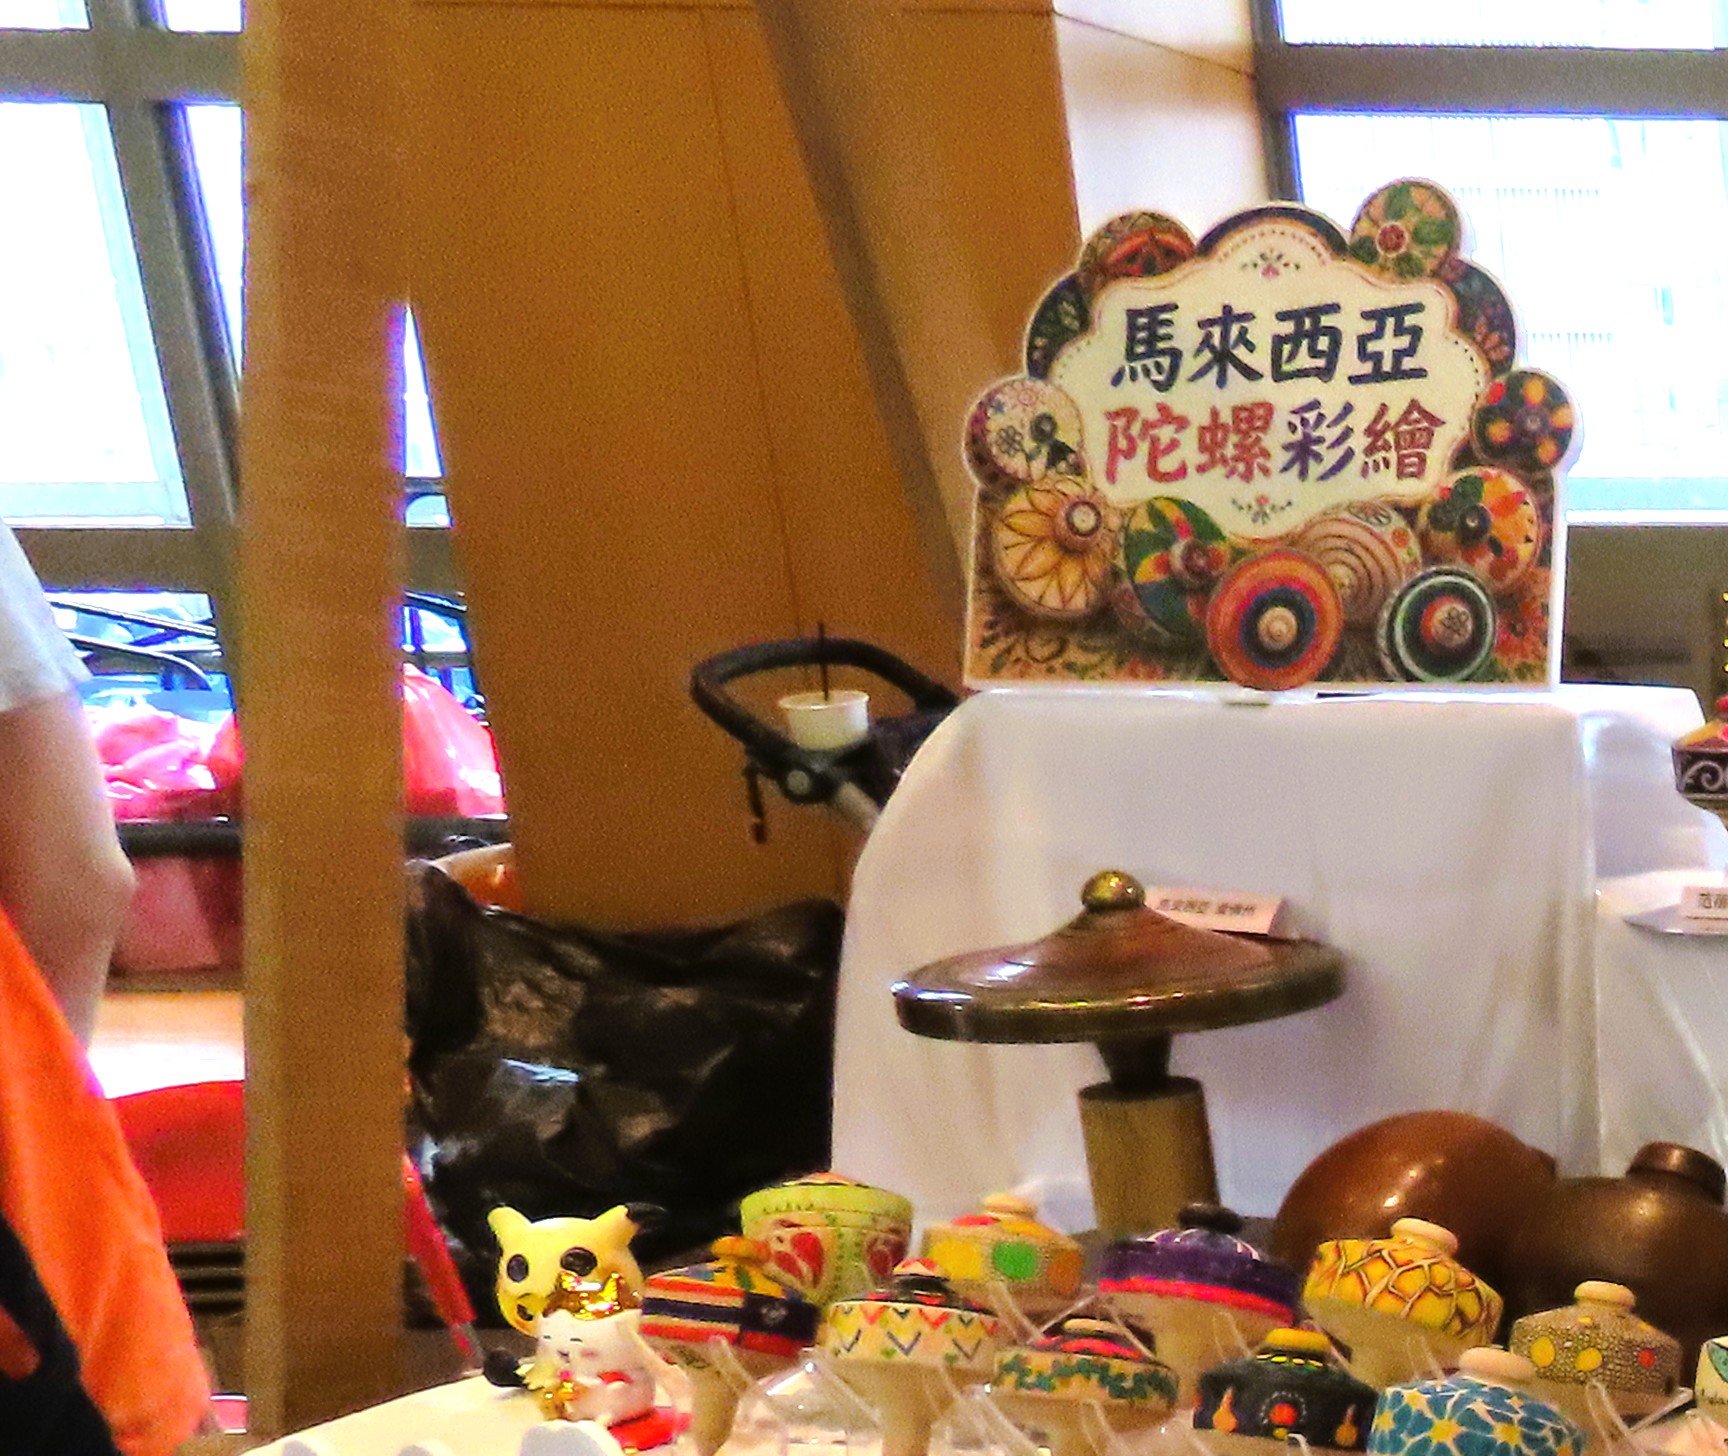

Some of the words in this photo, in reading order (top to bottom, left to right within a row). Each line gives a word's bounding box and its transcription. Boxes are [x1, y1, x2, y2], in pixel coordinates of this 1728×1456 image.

[1108, 301, 1430, 392] 馬來西亞
[1103, 398, 1447, 485] 陀螺彩繪
